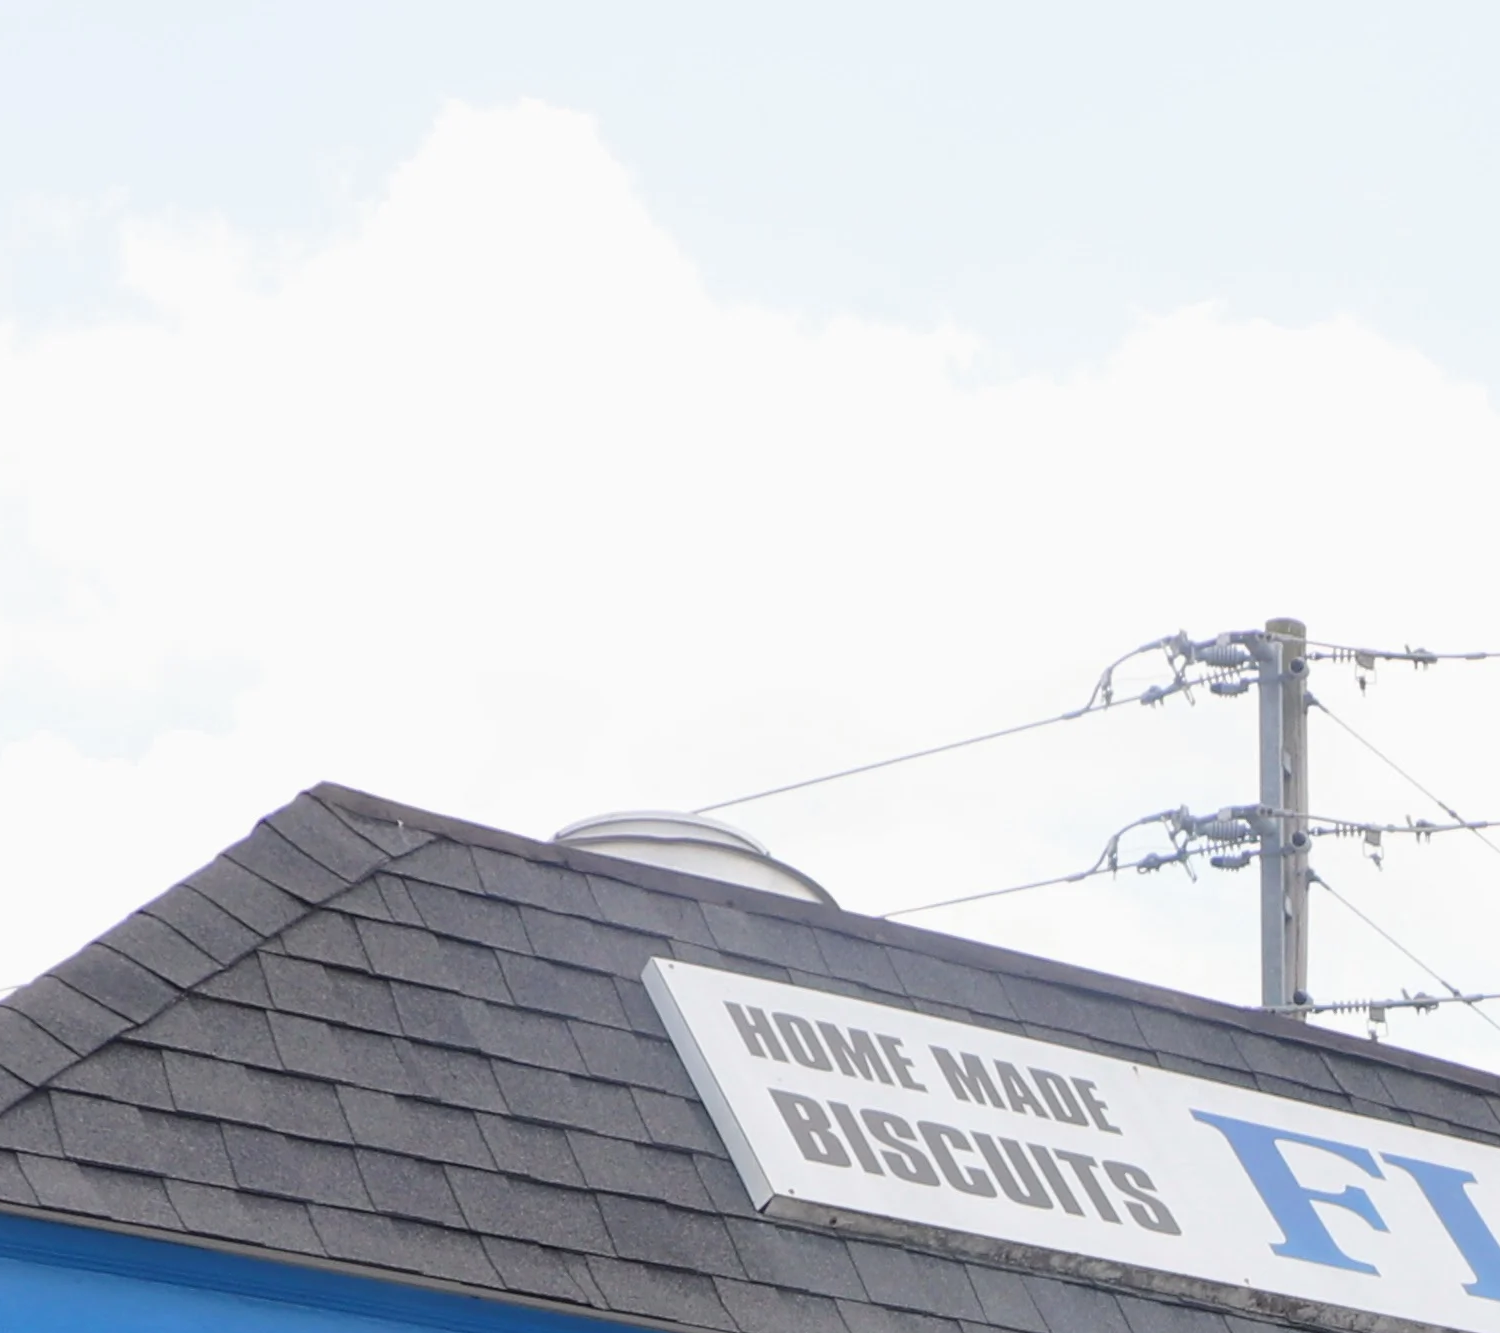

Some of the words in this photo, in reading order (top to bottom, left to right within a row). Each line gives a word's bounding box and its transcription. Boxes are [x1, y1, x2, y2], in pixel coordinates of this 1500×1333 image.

[723, 1000, 928, 1093] HOME
[928, 1044, 1123, 1135] MADE
[767, 1087, 1182, 1236] BISCUITS
